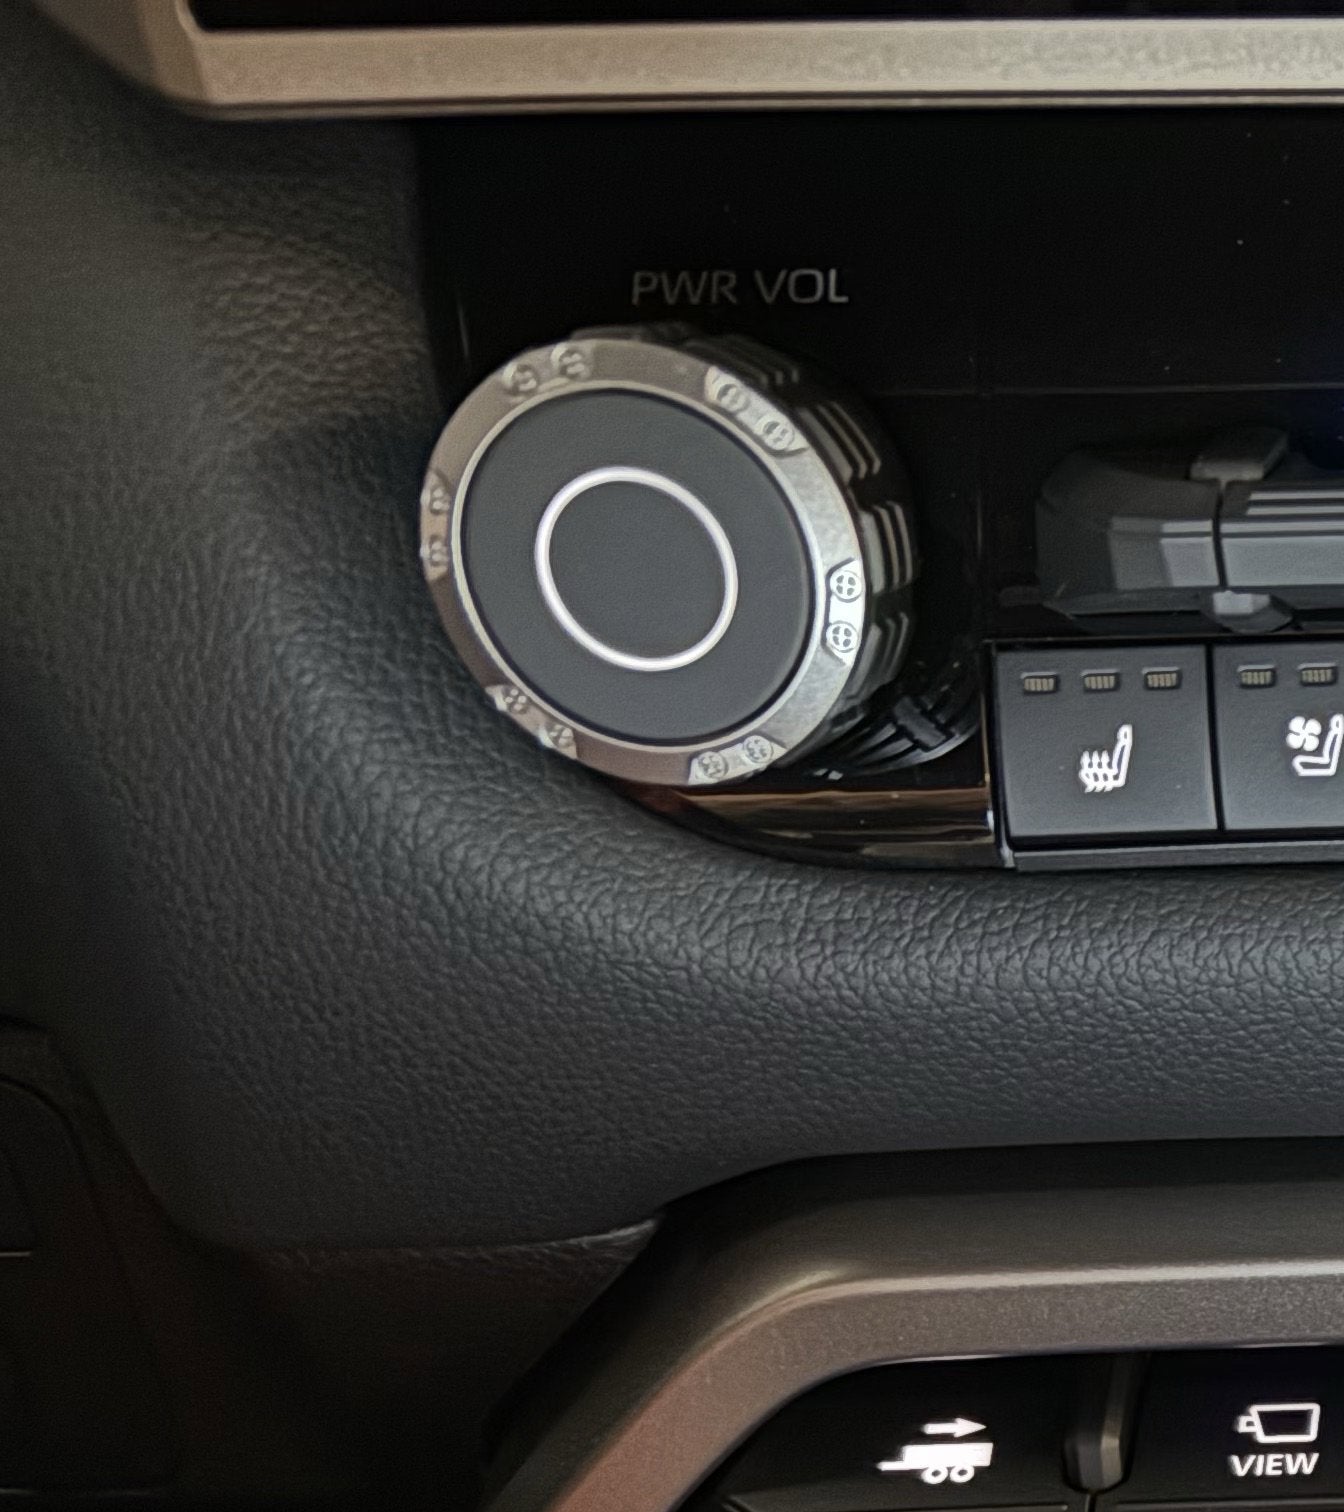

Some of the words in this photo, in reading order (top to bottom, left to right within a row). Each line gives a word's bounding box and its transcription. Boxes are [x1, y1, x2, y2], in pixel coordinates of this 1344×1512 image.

[631, 269, 738, 305] PWR
[754, 268, 849, 304] VOL
[1230, 1452, 1320, 1477] VIEW
